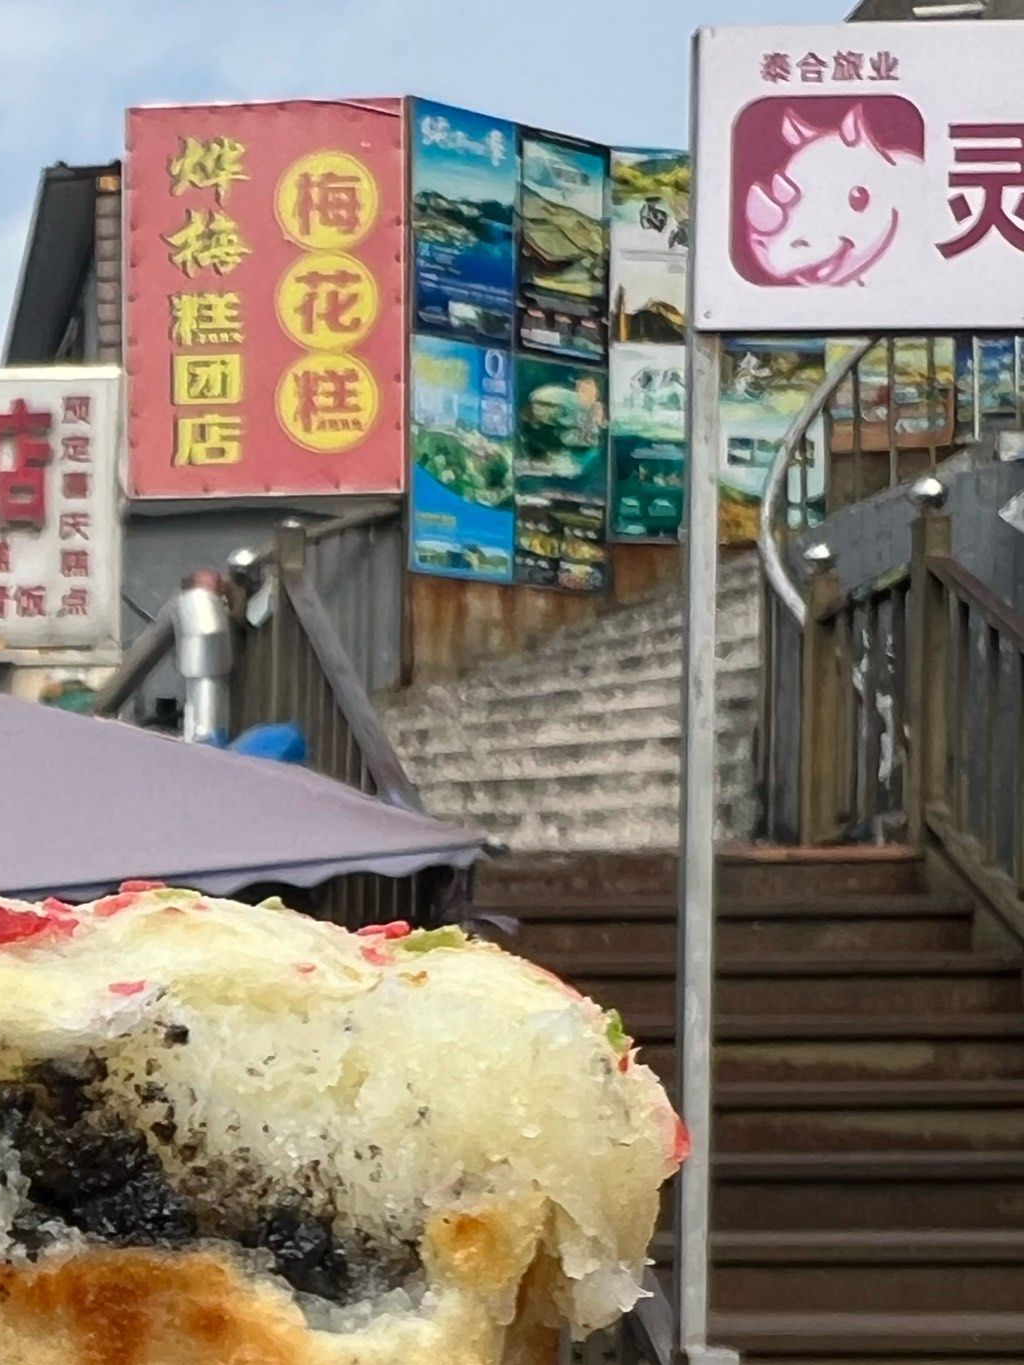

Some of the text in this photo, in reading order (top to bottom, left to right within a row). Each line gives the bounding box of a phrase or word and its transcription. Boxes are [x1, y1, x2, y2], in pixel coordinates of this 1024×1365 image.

[936, 122, 1024, 260] 灵
[291, 170, 368, 434] 梅花糕
